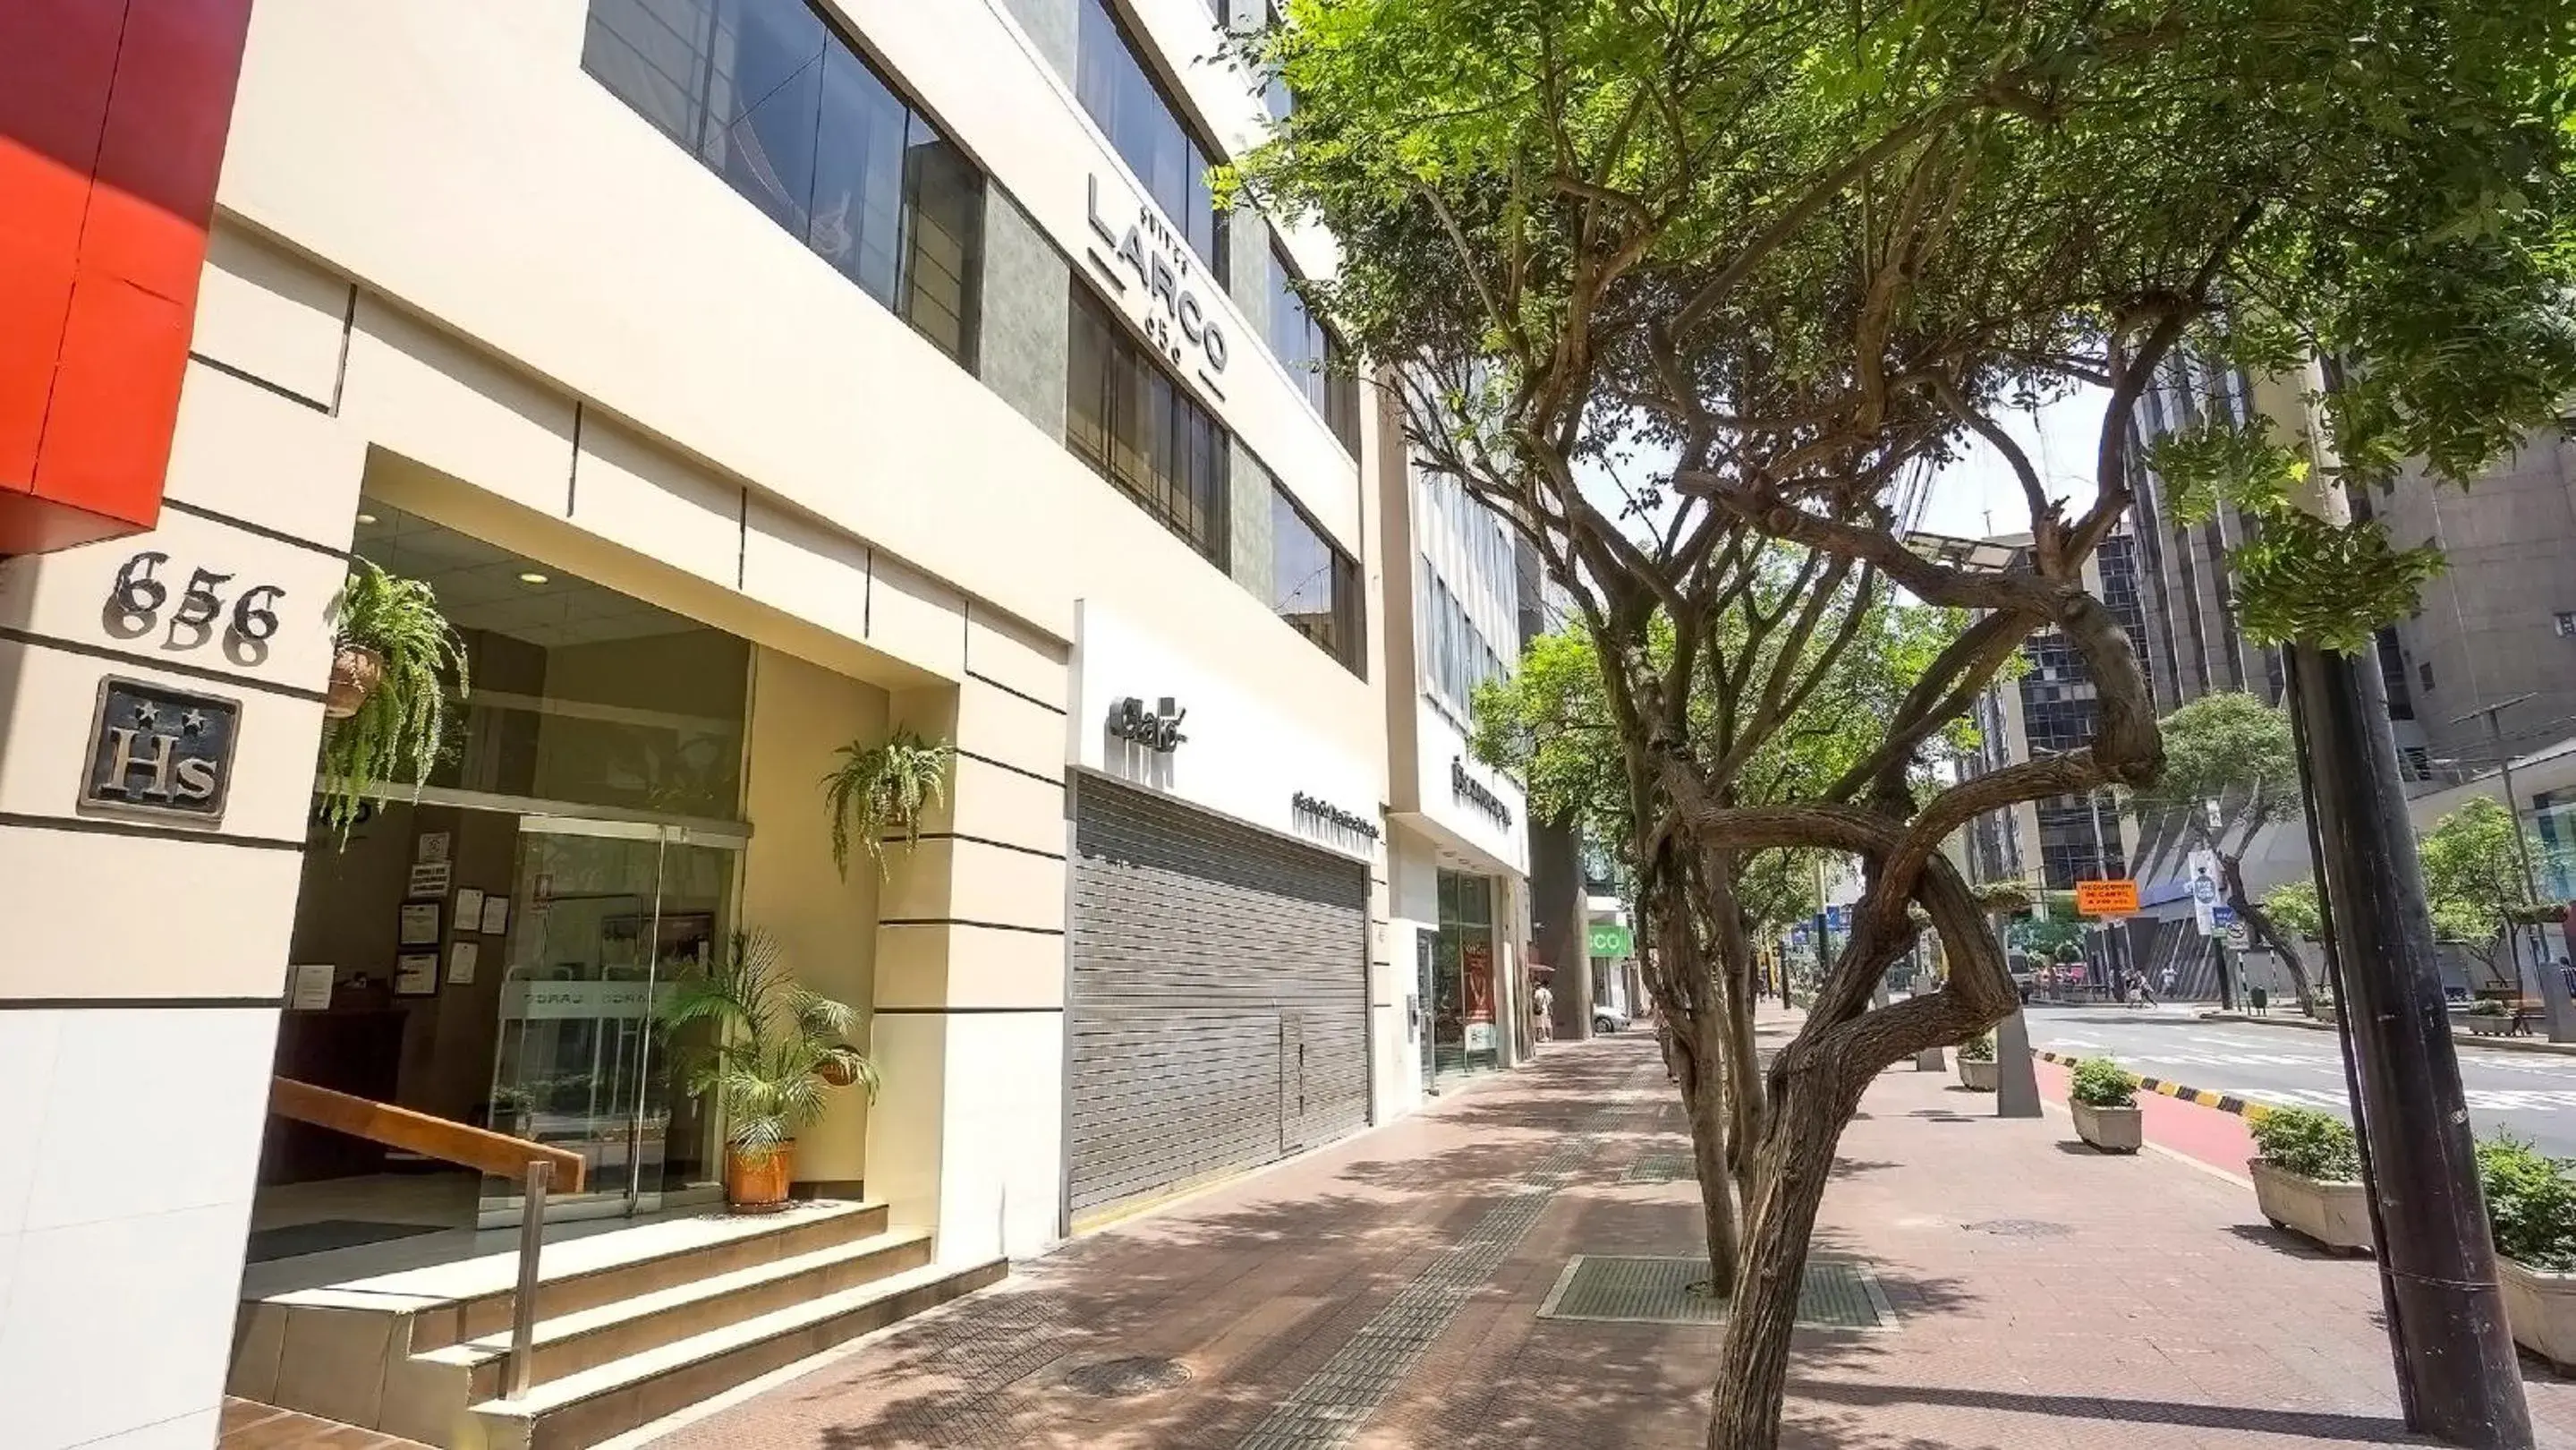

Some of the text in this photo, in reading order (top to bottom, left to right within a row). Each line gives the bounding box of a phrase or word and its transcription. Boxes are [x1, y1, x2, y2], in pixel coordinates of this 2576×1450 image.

[1088, 173, 1228, 374] LARCO
[1140, 205, 1188, 277] SUITES
[117, 551, 286, 640] 656
[99, 726, 217, 804] Hs
